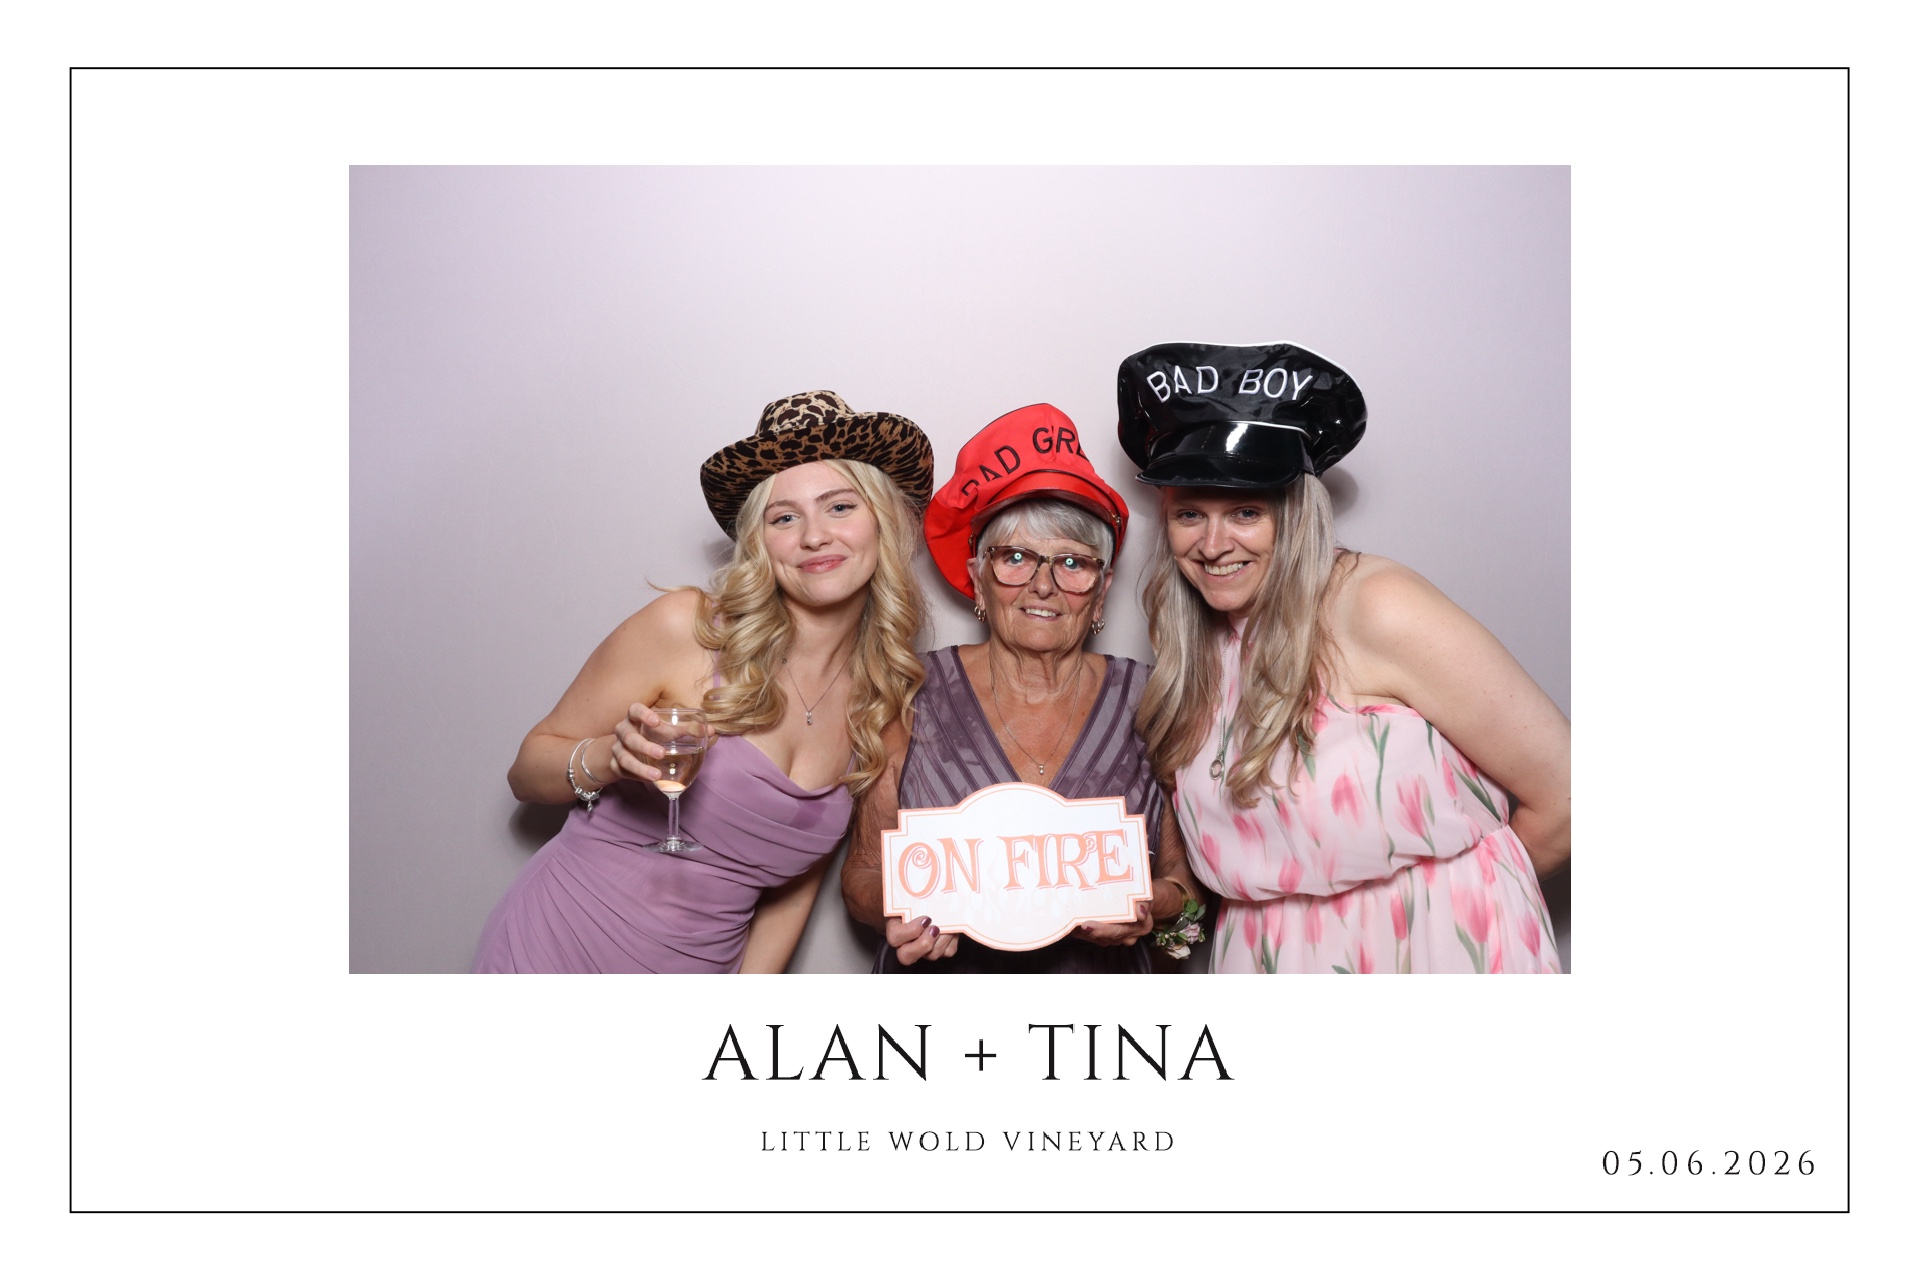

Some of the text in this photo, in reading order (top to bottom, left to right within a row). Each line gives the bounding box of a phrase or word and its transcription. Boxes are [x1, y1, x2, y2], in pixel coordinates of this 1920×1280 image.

[1146, 365, 1314, 403] BAD BOY
[898, 828, 1134, 900] ON FIRE
